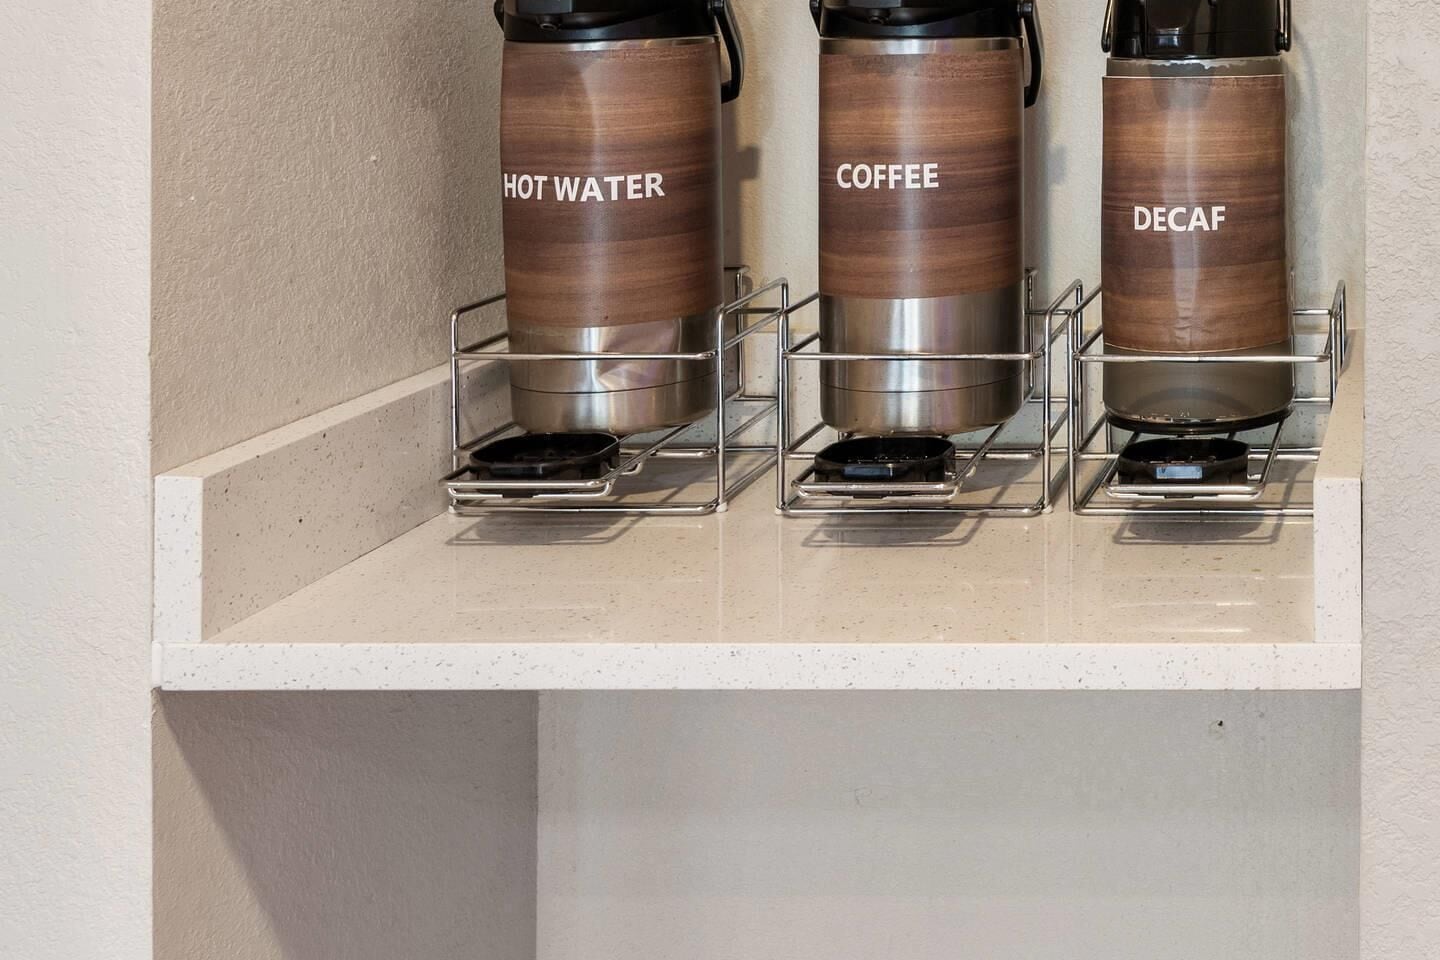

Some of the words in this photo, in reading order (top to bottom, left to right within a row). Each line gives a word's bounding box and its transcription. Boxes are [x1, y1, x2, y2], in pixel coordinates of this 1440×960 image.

[503, 173, 547, 200] HOT
[554, 172, 665, 202] WATER
[836, 163, 939, 189] COFFEE
[1134, 205, 1226, 232] DECAF
